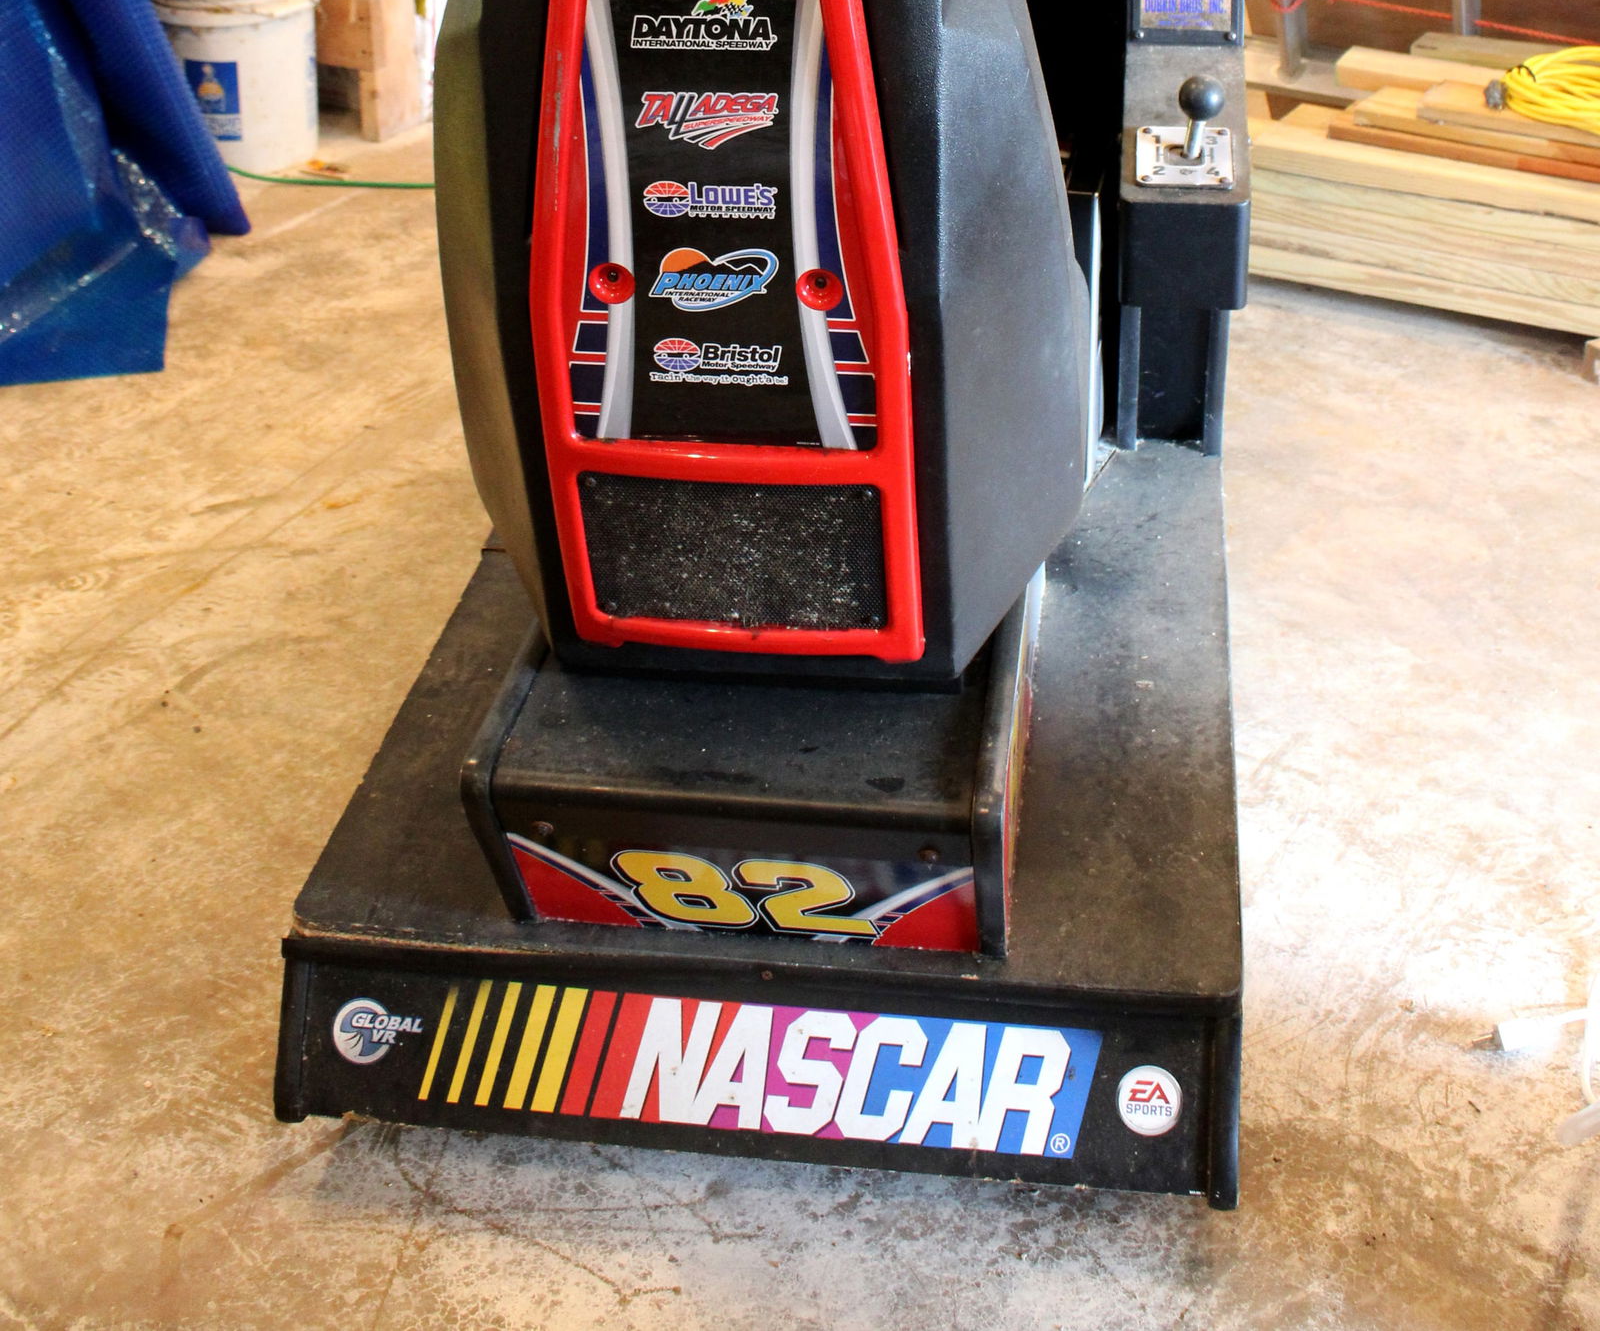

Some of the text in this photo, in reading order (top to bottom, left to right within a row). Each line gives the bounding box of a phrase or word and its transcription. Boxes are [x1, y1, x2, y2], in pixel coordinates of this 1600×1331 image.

[633, 15, 773, 40] DAYTONA
[632, 39, 773, 49] INTERNATIONAL SPEEDWAY
[637, 92, 778, 133] TALLADEGA
[682, 114, 773, 131] SUPERSPEEDWAY
[1206, 136, 1218, 145] 3
[1153, 166, 1165, 175] 2
[690, 204, 775, 213] MOTOR SPEEDWAY
[652, 271, 765, 295] PHOENIX
[664, 290, 732, 298] INTERNATIONAL
[702, 344, 780, 363] Bristol
[701, 361, 778, 371] Motor Speedway
[686, 373, 700, 381] the
[702, 375, 718, 384] way
[611, 850, 880, 937] 82
[352, 1012, 424, 1033] GLOBAL
[371, 1029, 396, 1044] VR
[620, 998, 1071, 1155] NASCAR
[1128, 1080, 1171, 1104] EA
[1126, 1103, 1173, 1117] SPORTS
